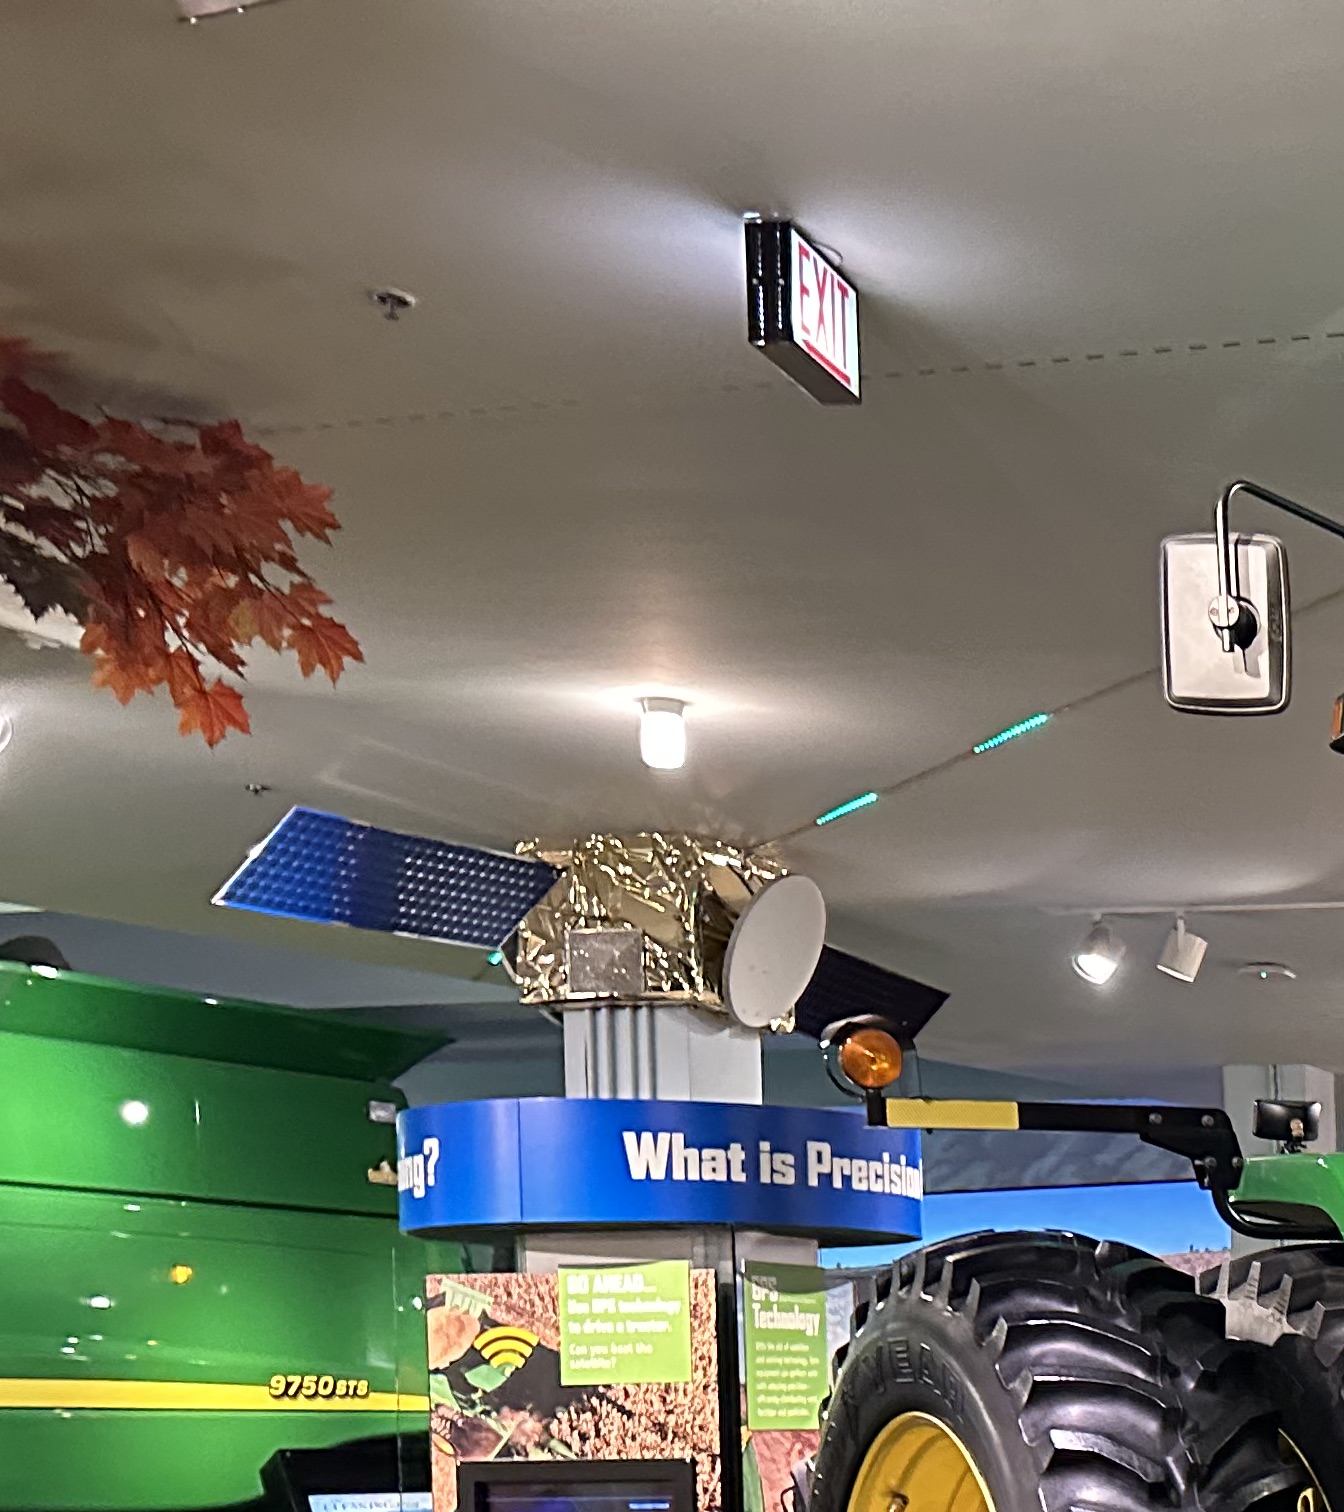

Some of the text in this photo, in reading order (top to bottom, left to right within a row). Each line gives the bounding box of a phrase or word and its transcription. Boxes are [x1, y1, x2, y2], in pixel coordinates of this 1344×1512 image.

[798, 242, 850, 370] EXIT
[622, 1131, 747, 1183] What
[759, 1141, 796, 1186] is
[752, 1303, 820, 1336] Technology
